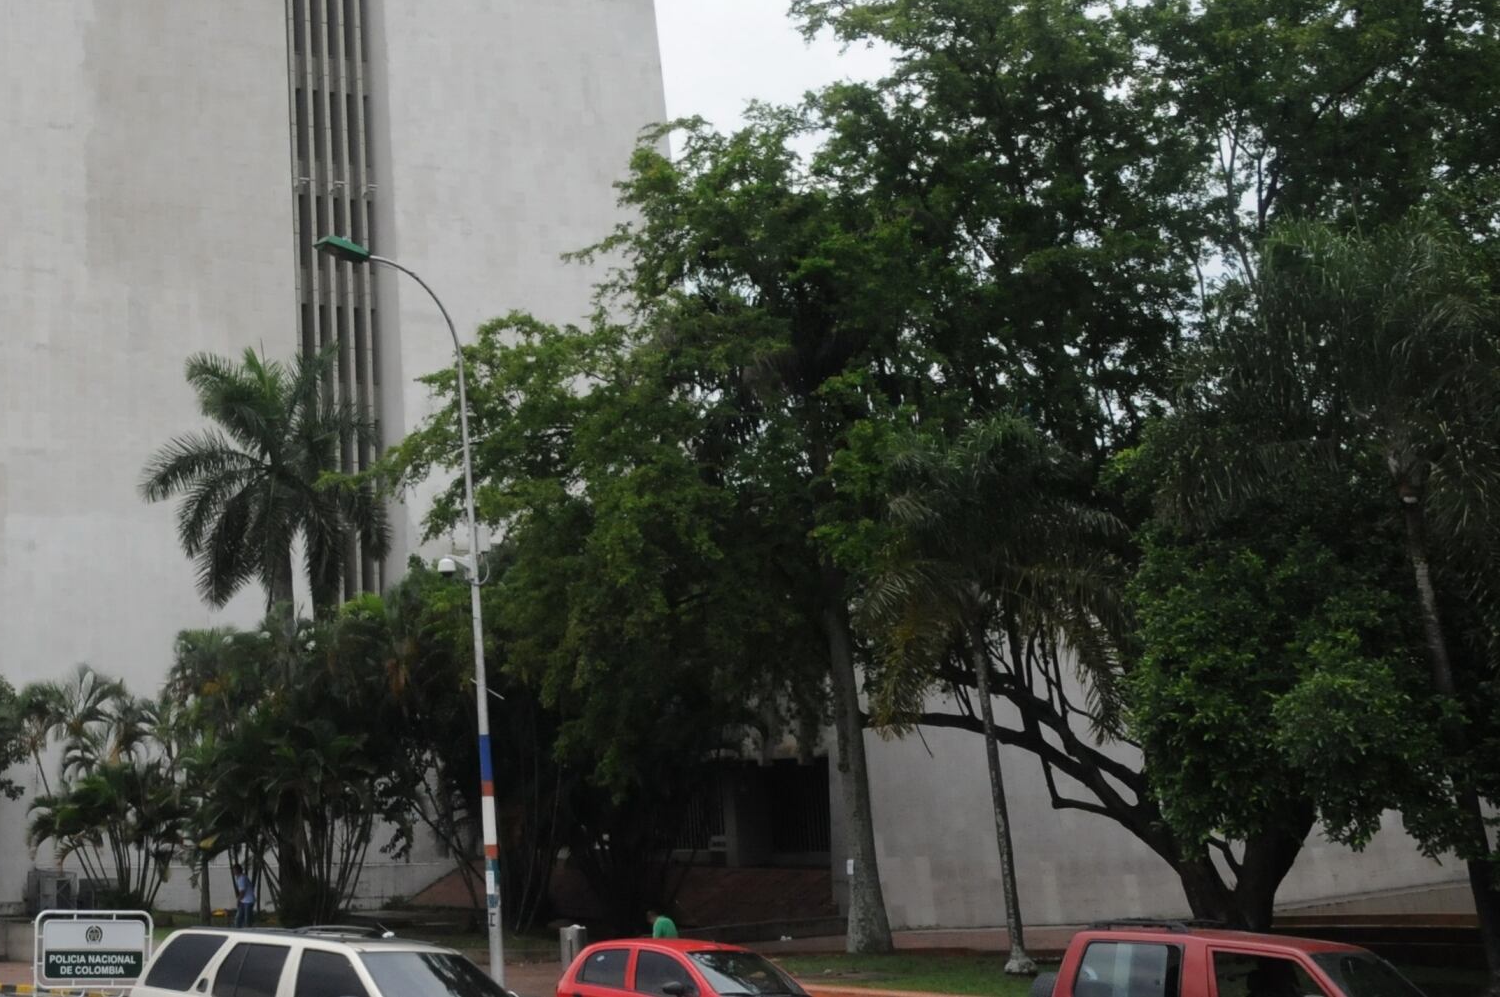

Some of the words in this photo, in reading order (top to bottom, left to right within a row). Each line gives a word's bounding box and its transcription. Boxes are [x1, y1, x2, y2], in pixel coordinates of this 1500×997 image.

[49, 954, 86, 964] POLICIA
[88, 955, 136, 964] NACIONAL
[60, 966, 73, 975] DE
[75, 966, 125, 975] COLOMBIA
